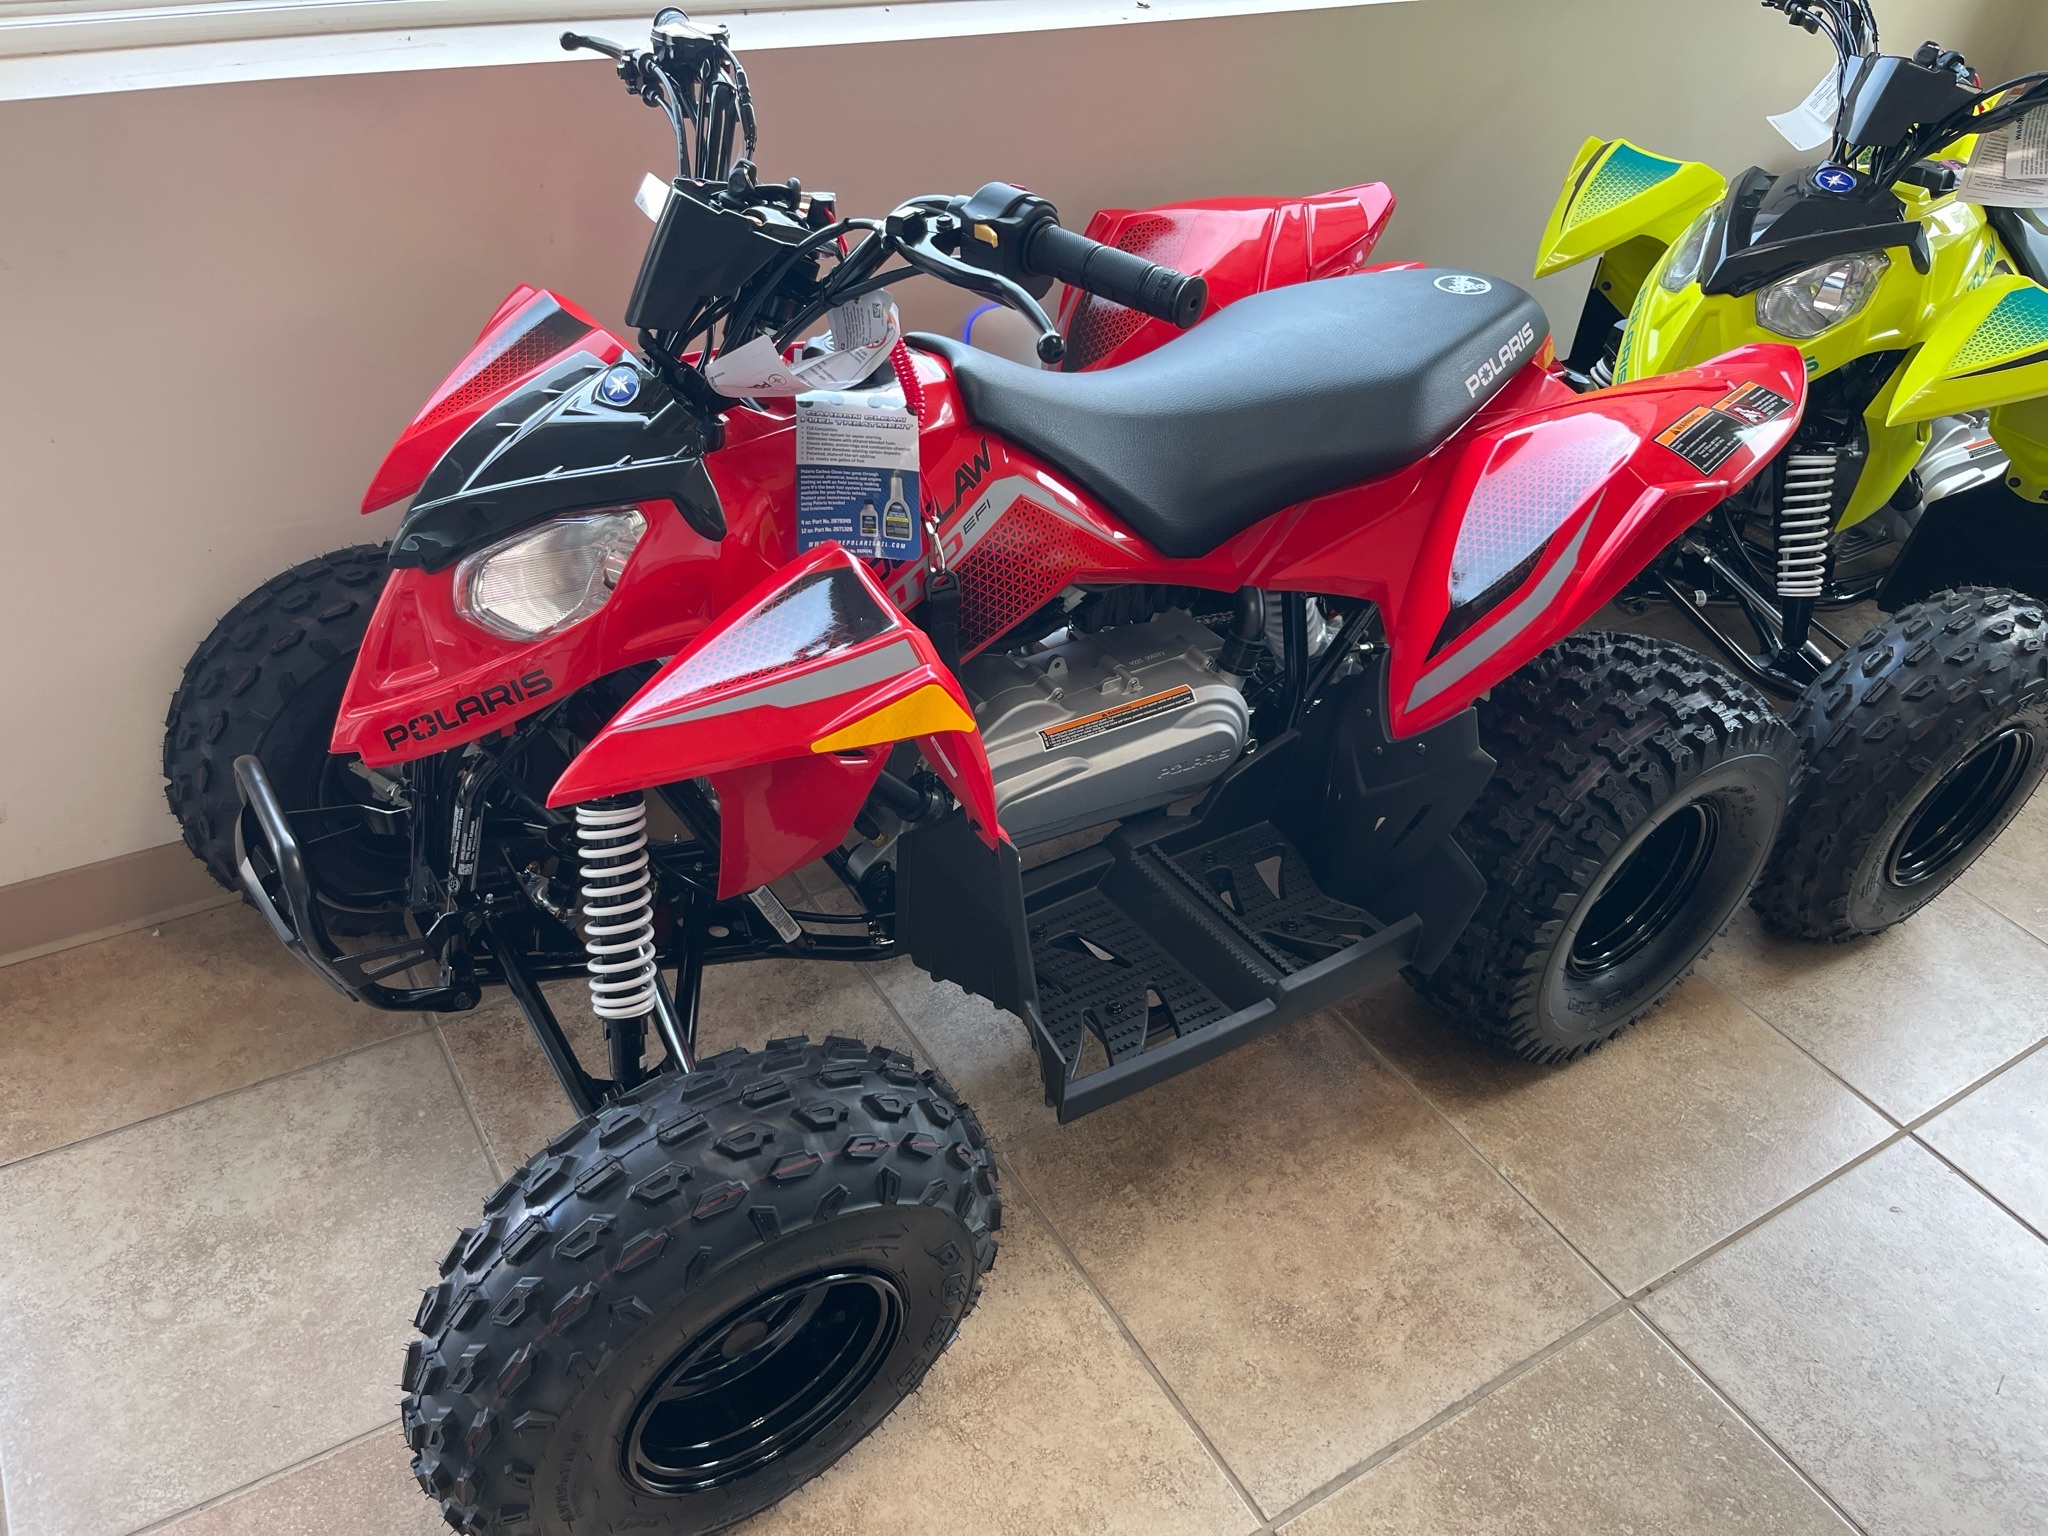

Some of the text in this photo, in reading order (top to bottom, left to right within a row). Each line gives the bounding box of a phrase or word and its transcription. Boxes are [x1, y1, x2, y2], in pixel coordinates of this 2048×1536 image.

[2014, 114, 2025, 141] WARN
[1616, 286, 1648, 384] POLARIS
[1464, 321, 1535, 399] POLARIS
[800, 416, 913, 430] FUEL TREATMENT
[806, 410, 907, 422] CARBON CLEAN
[962, 498, 992, 536] EFI
[382, 668, 553, 753] POLARIS
